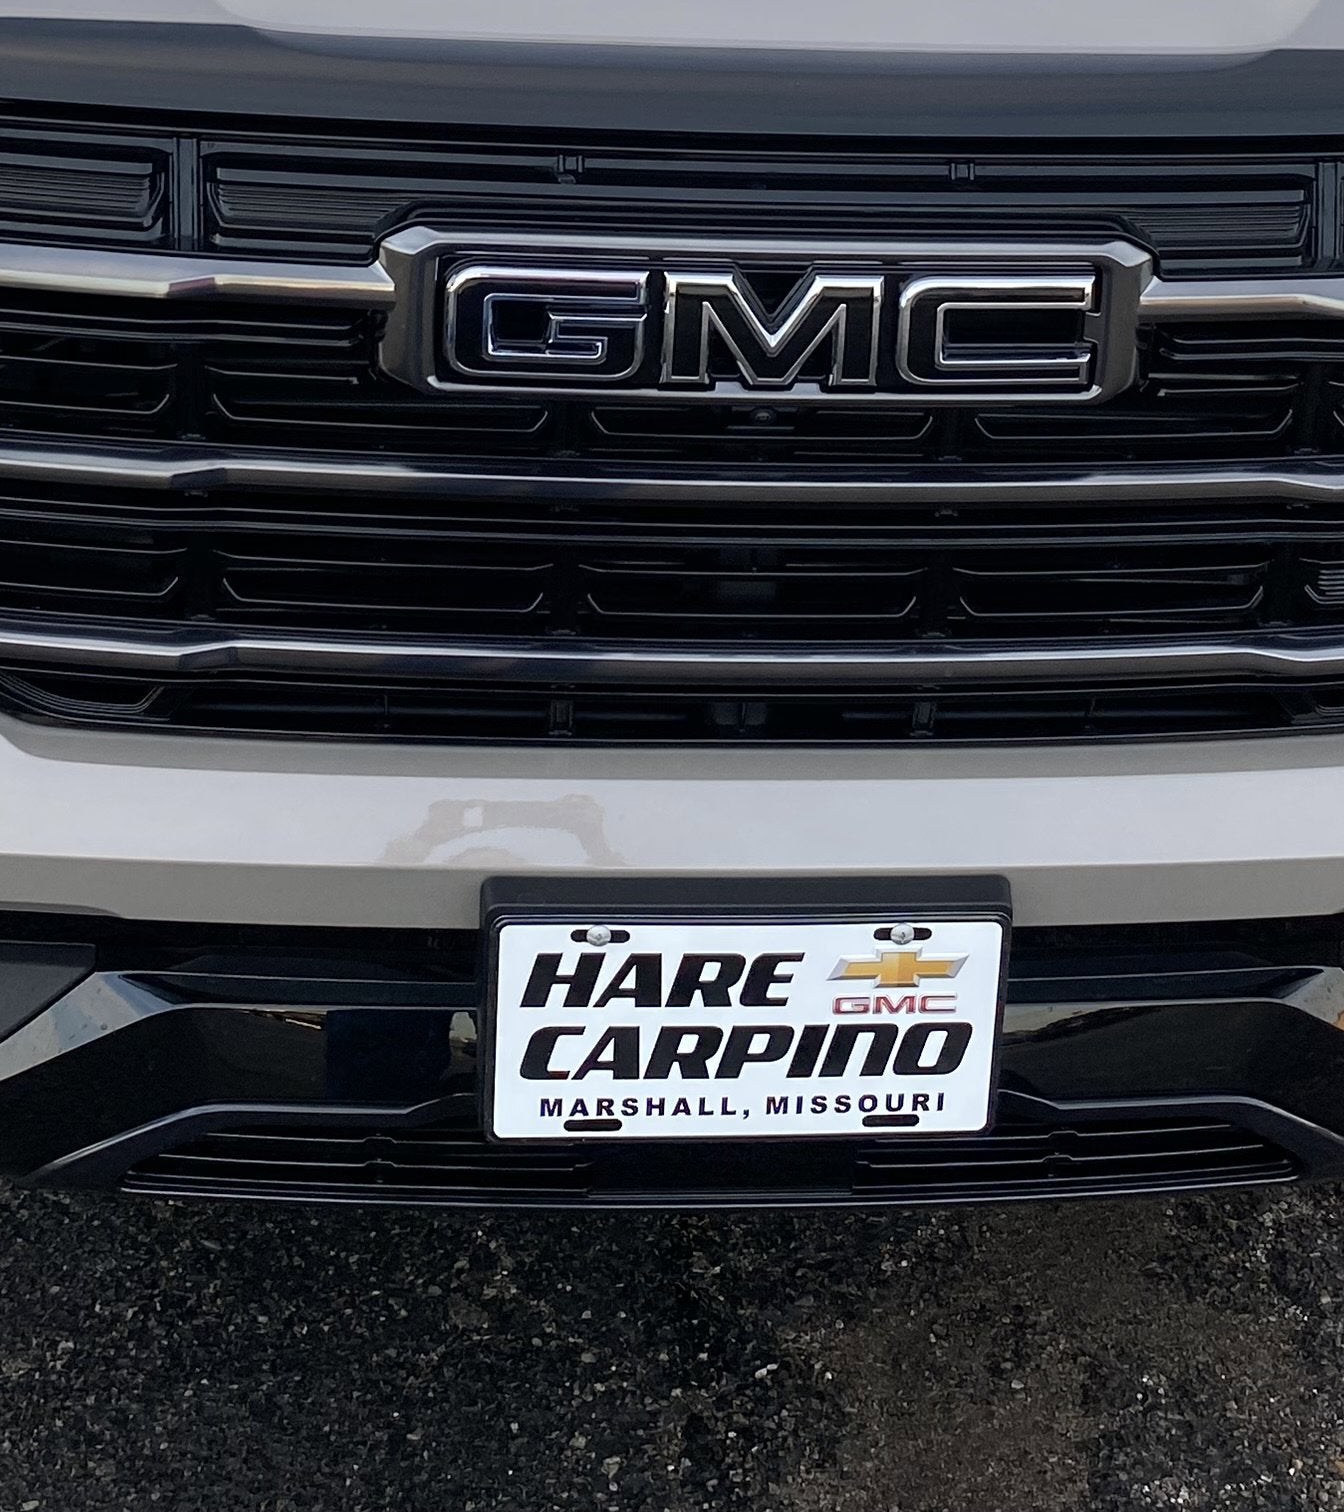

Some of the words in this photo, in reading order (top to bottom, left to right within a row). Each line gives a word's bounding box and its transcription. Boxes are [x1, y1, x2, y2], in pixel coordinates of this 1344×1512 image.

[444, 265, 1097, 386] GMC
[519, 951, 805, 1008] HARE
[831, 992, 958, 1015] GMC
[518, 1022, 973, 1080] CARPINO
[540, 1095, 751, 1120] MARSHALL,
[765, 1092, 946, 1115] MISSOURI
